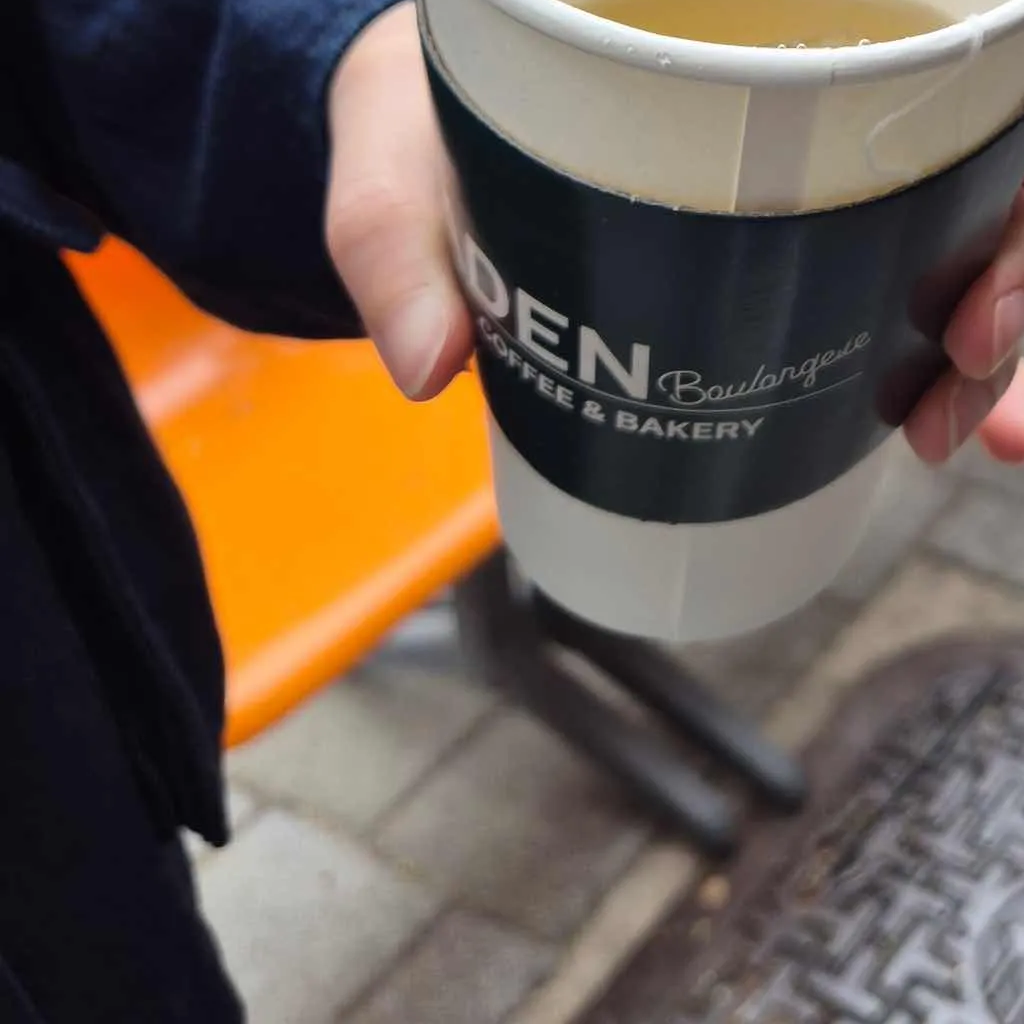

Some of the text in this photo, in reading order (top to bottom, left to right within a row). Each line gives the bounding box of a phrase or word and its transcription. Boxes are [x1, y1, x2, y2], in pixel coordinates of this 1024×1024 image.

[479, 315, 765, 441] COFFEE & BAKERY
